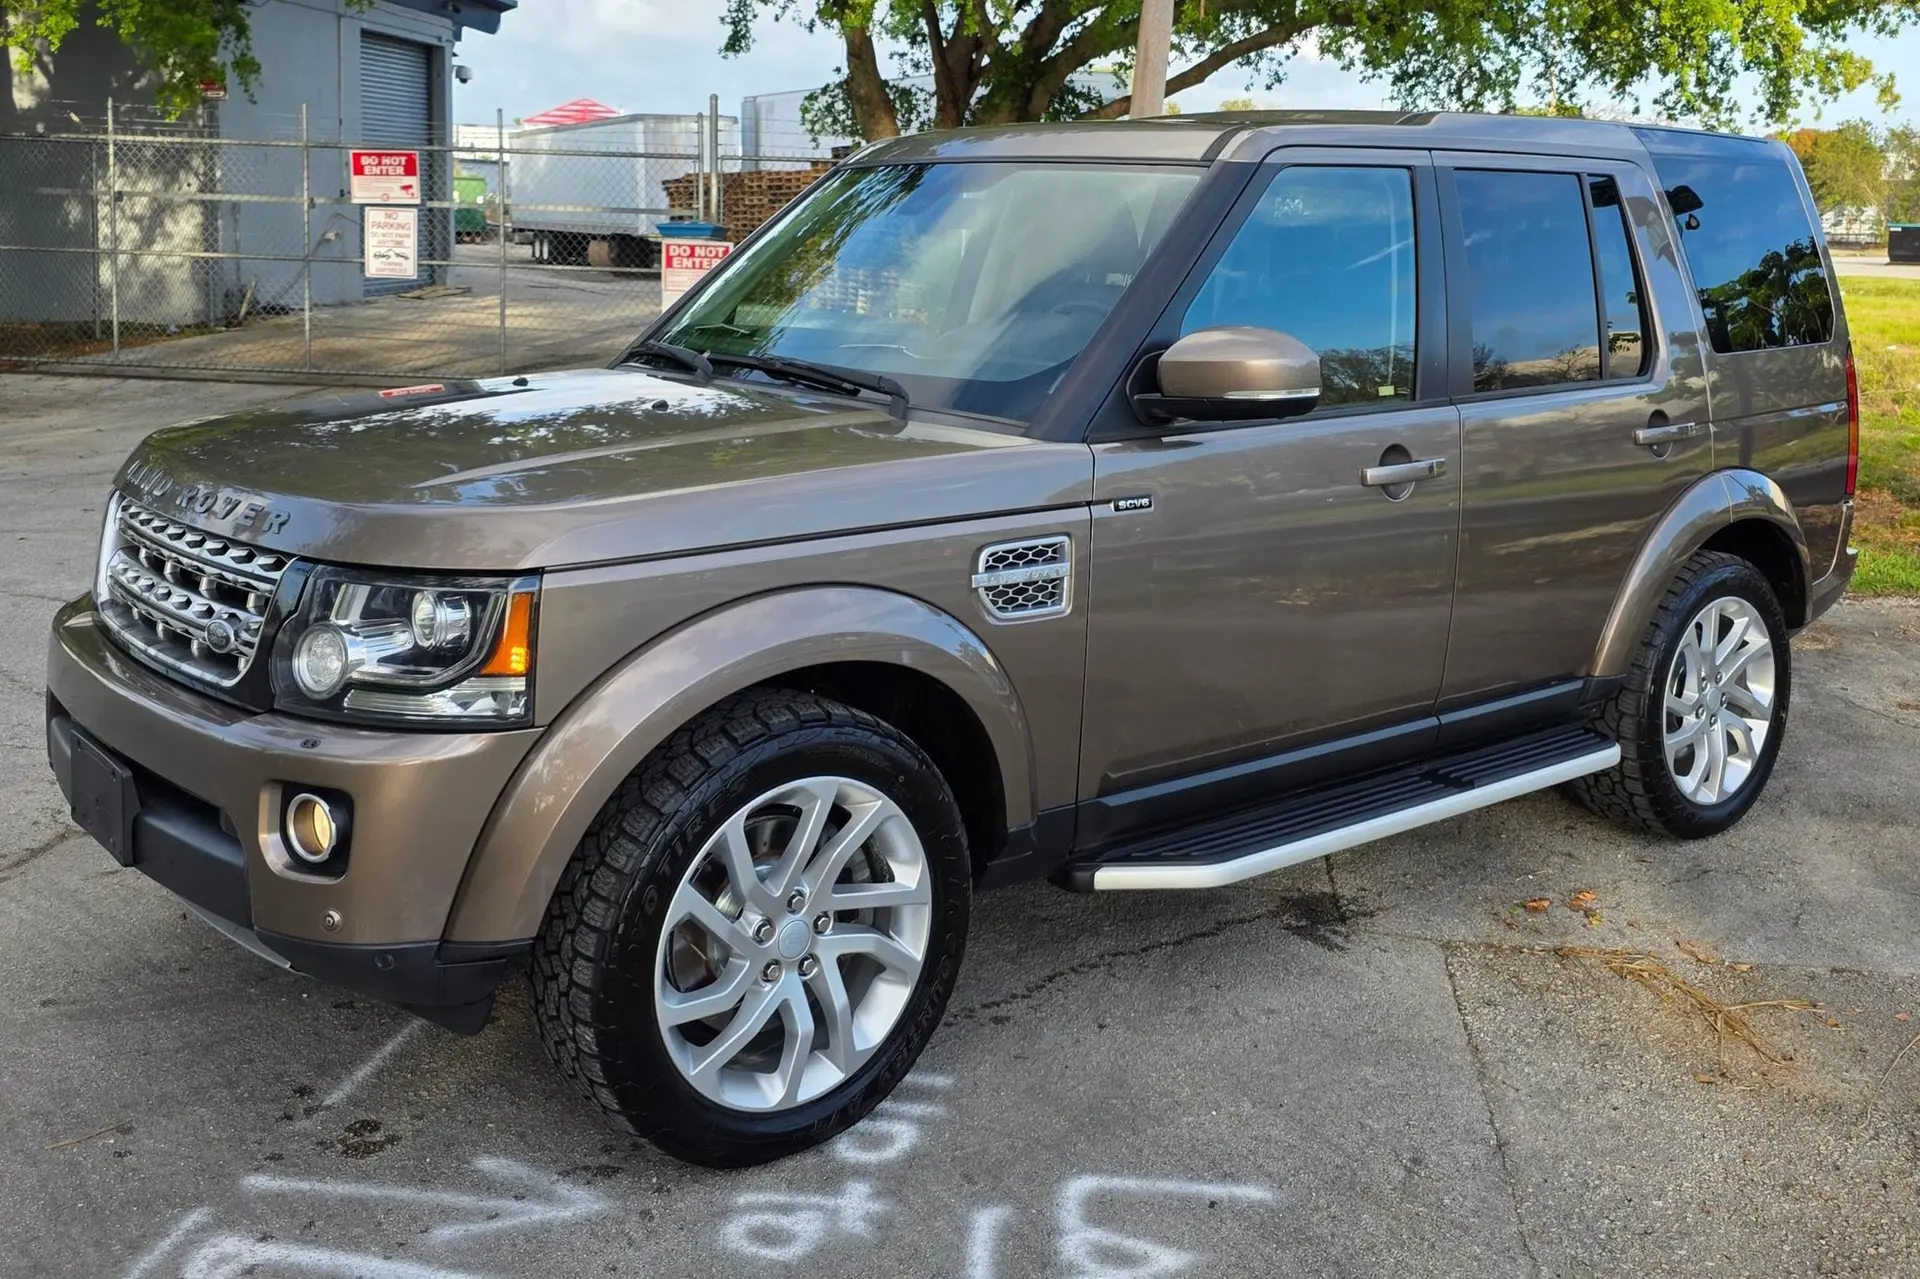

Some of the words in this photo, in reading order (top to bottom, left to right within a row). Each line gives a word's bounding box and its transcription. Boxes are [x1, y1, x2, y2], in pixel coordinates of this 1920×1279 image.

[361, 156, 379, 166] DO
[381, 155, 407, 165] NOT
[364, 166, 405, 175] ENTER
[384, 212, 398, 220] NO
[371, 221, 411, 230] PARKING
[669, 245, 691, 257] DO
[694, 246, 725, 257] NOT
[1117, 497, 1151, 510] SCV6
[176, 484, 291, 535] ROVER
